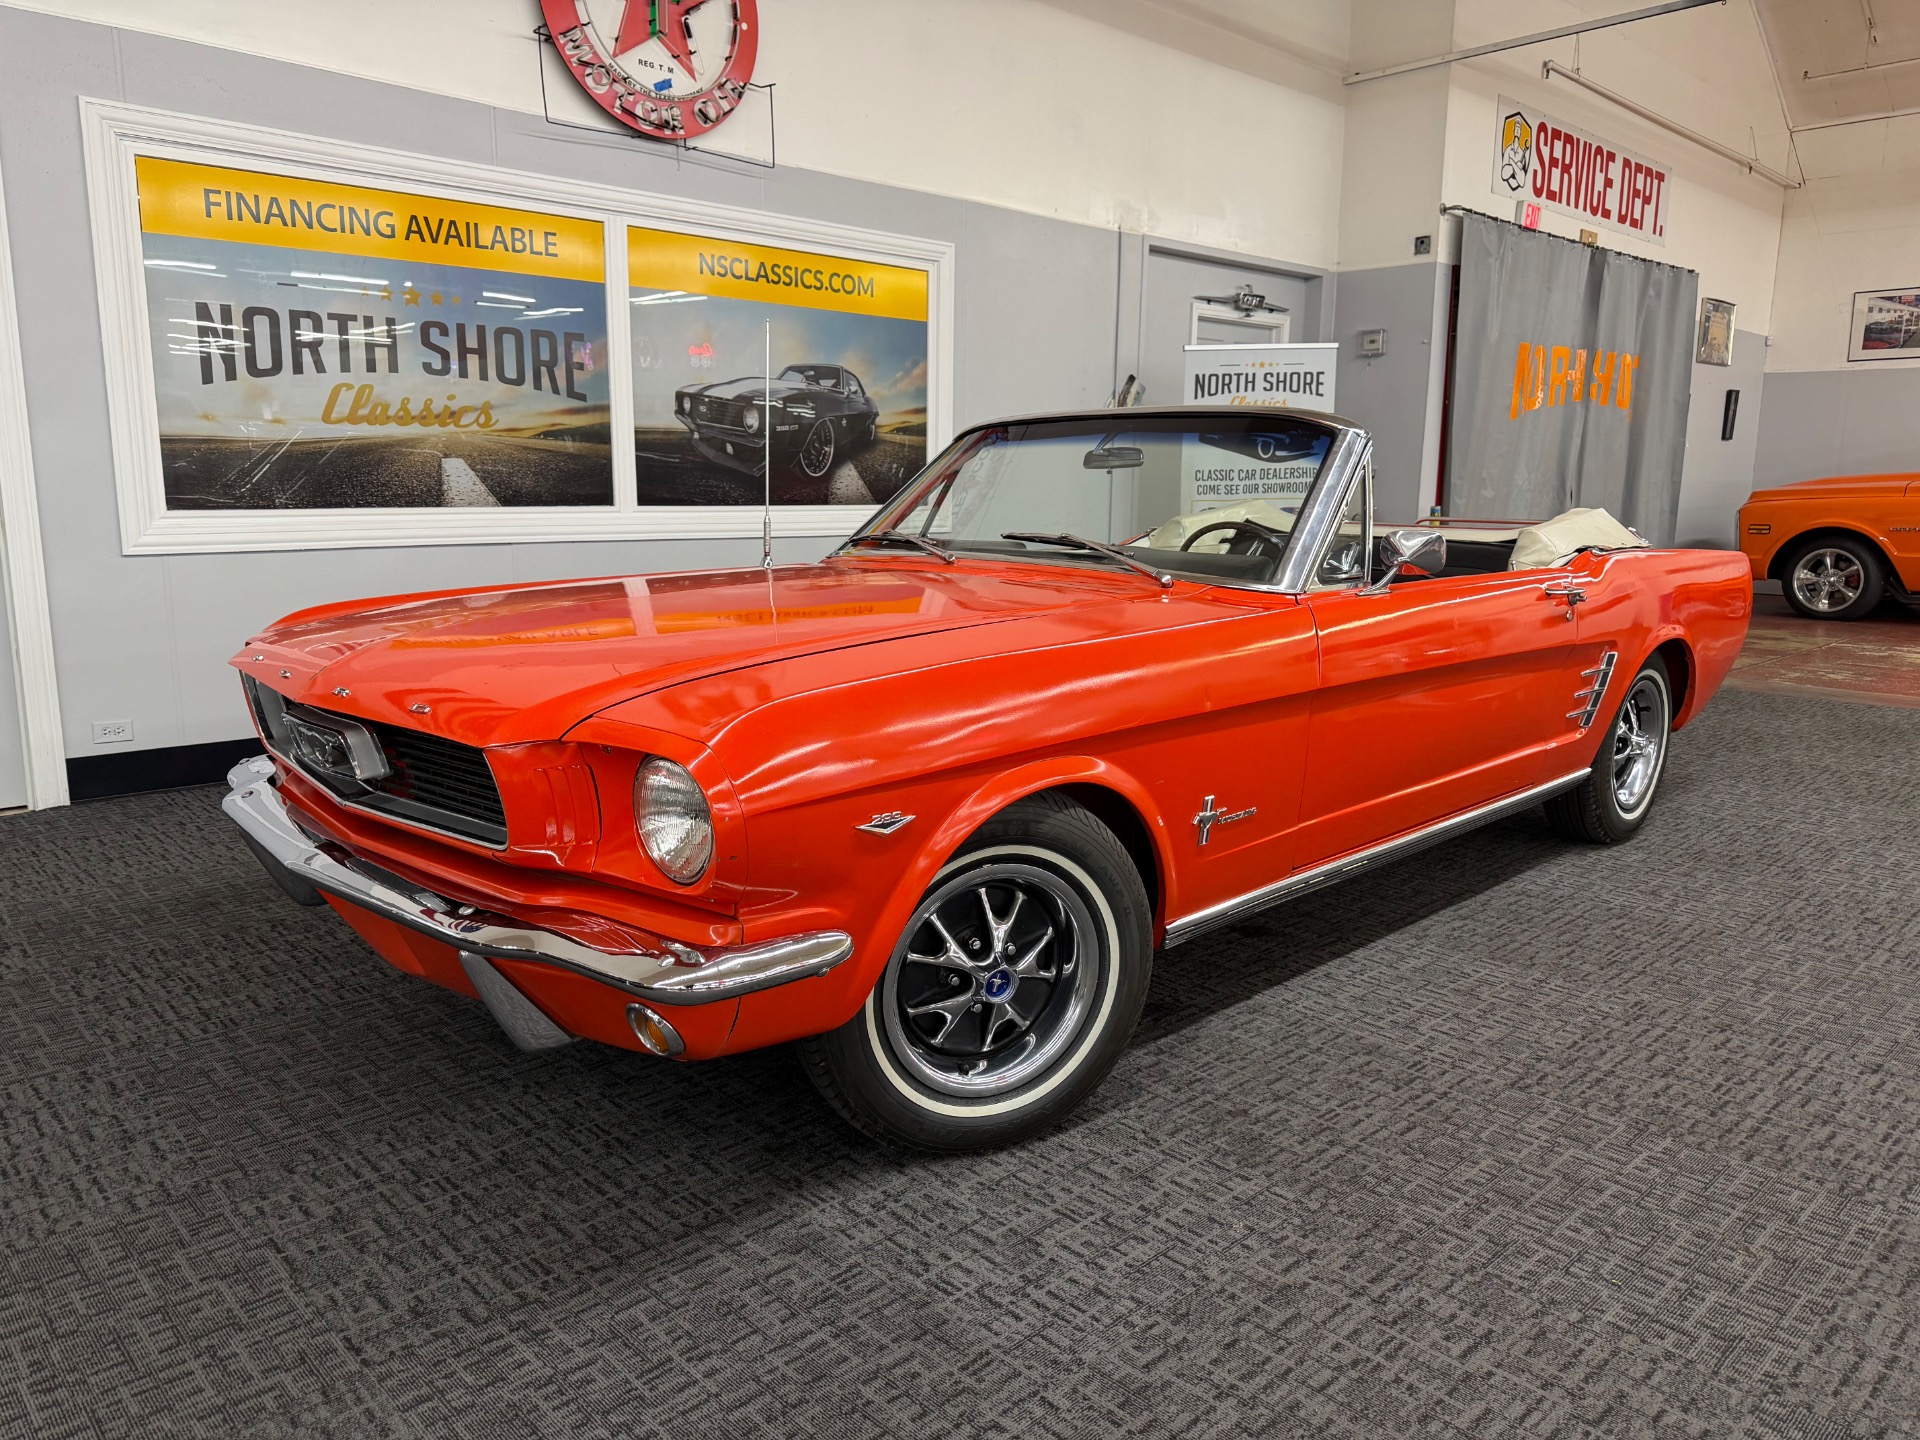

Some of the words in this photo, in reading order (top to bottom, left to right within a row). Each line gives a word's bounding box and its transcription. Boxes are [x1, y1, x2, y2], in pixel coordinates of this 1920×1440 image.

[557, 24, 686, 135] MOTOR
[693, 76, 749, 128] OIL
[627, 79, 637, 88] BY
[639, 86, 652, 97] THE
[1532, 121, 1616, 220] SERVICE
[1617, 156, 1665, 238] DEPT.
[203, 187, 396, 239] FINANCING
[404, 214, 559, 258] AVAILABLE
[1524, 203, 1541, 229] EXIT
[698, 252, 875, 299] NSCLASSICS.COM
[194, 301, 399, 386] NORTH
[419, 320, 588, 403] SHORE
[321, 382, 500, 430] Classics
[1194, 372, 1256, 400] NORTH
[1263, 371, 1325, 397] SHORE
[1194, 468, 1235, 482] CLASSIC
[1237, 468, 1256, 481] CAR
[1196, 483, 1222, 496] COME
[1224, 483, 1240, 495] SEE
[1242, 482, 1260, 494] OUR
